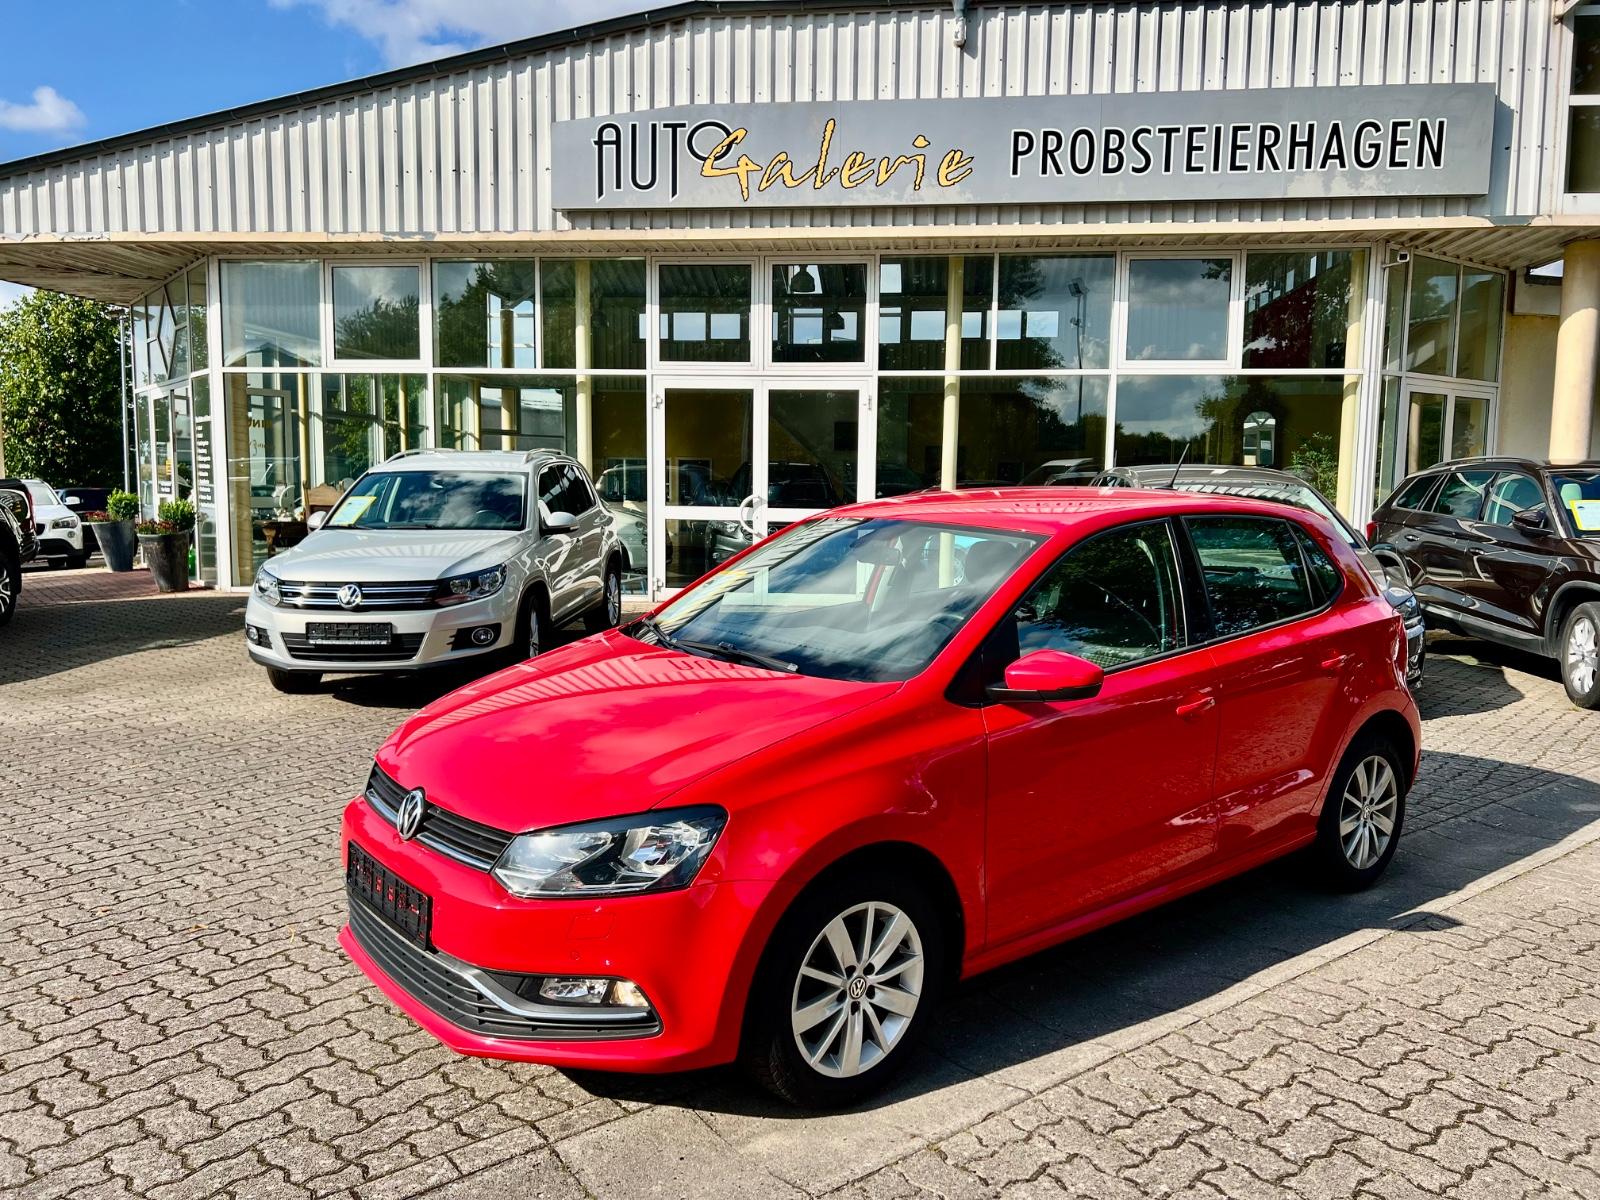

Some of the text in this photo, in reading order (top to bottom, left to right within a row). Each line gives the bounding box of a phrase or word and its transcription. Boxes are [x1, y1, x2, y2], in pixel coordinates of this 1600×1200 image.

[591, 117, 1449, 202] AUTO Galerie PROBSTEIERHAGEN
